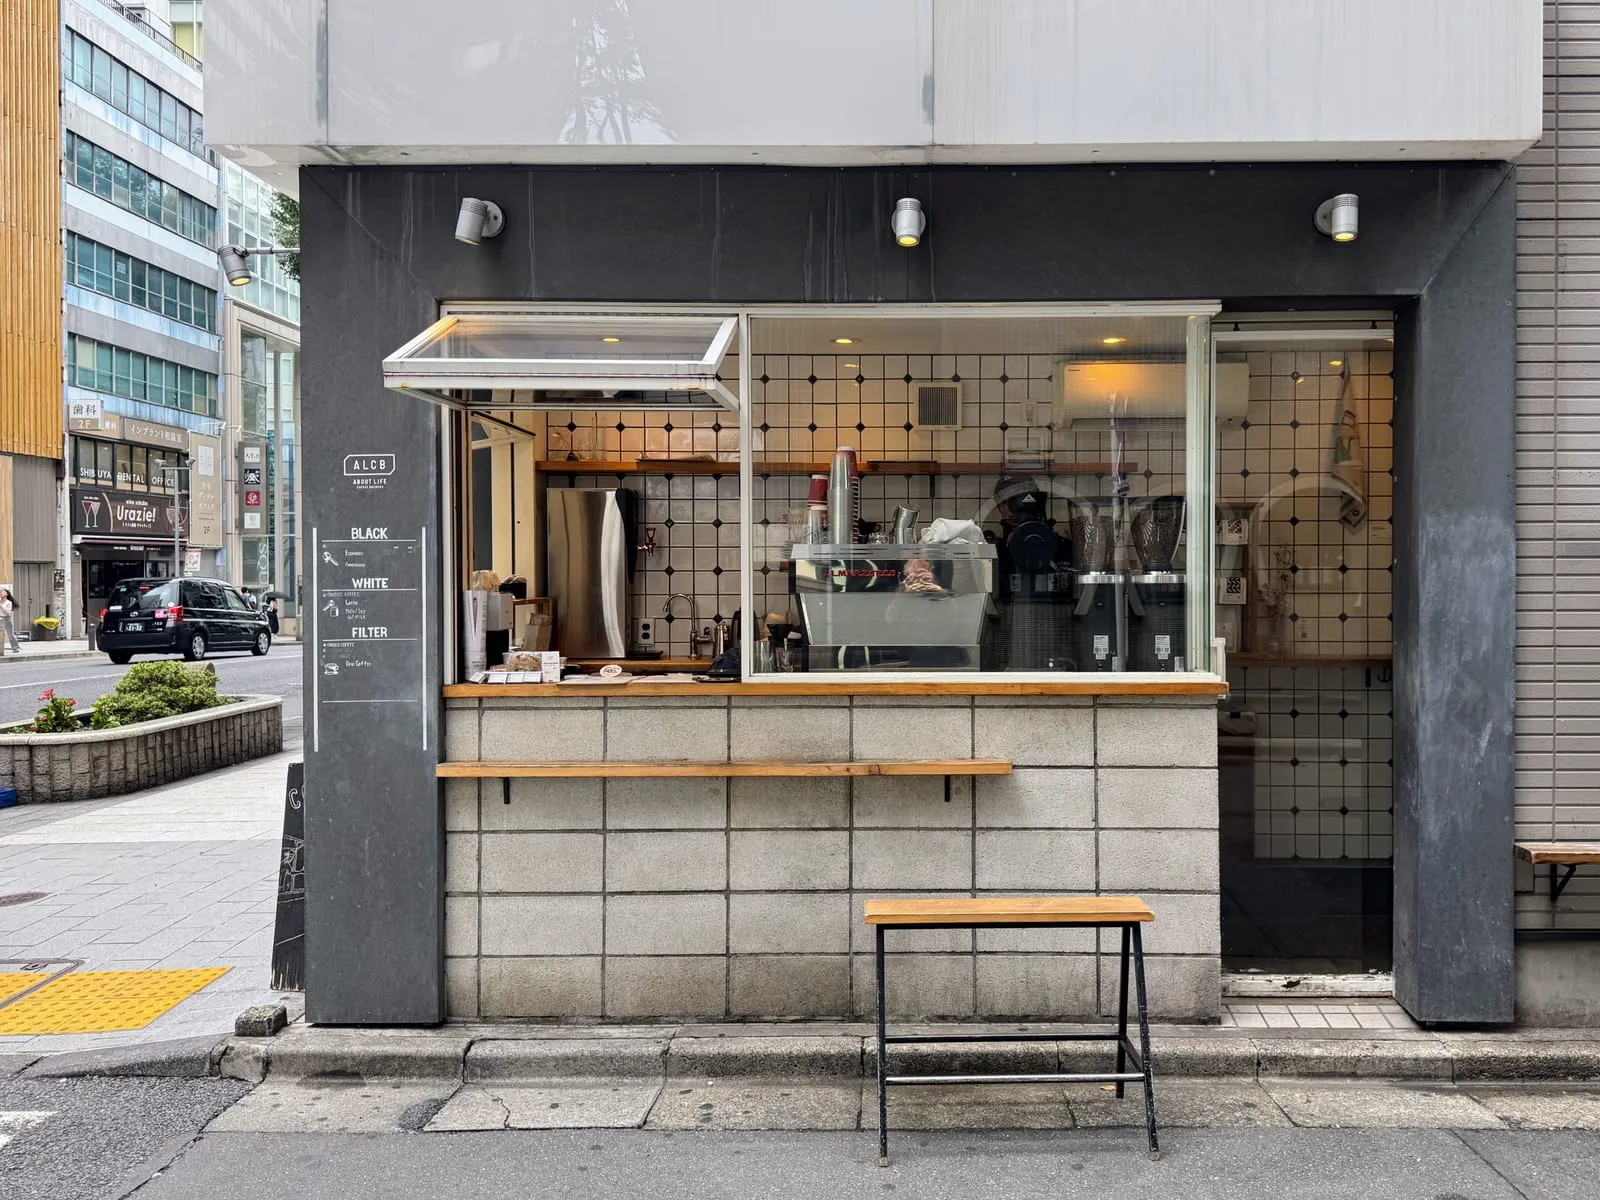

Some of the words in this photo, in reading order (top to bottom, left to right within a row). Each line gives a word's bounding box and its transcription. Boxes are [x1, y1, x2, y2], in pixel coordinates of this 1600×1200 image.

[73, 404, 97, 415] 歯科
[79, 420, 91, 429] 2F
[353, 459, 386, 470] ALCB
[80, 467, 112, 480] SHIBUYA
[117, 472, 145, 483] DENTAL
[151, 477, 175, 487] OFFICE
[117, 505, 156, 522] Urazie!
[351, 527, 388, 540] BLACK
[352, 578, 389, 589] WHITE
[352, 627, 388, 638] FILTER
